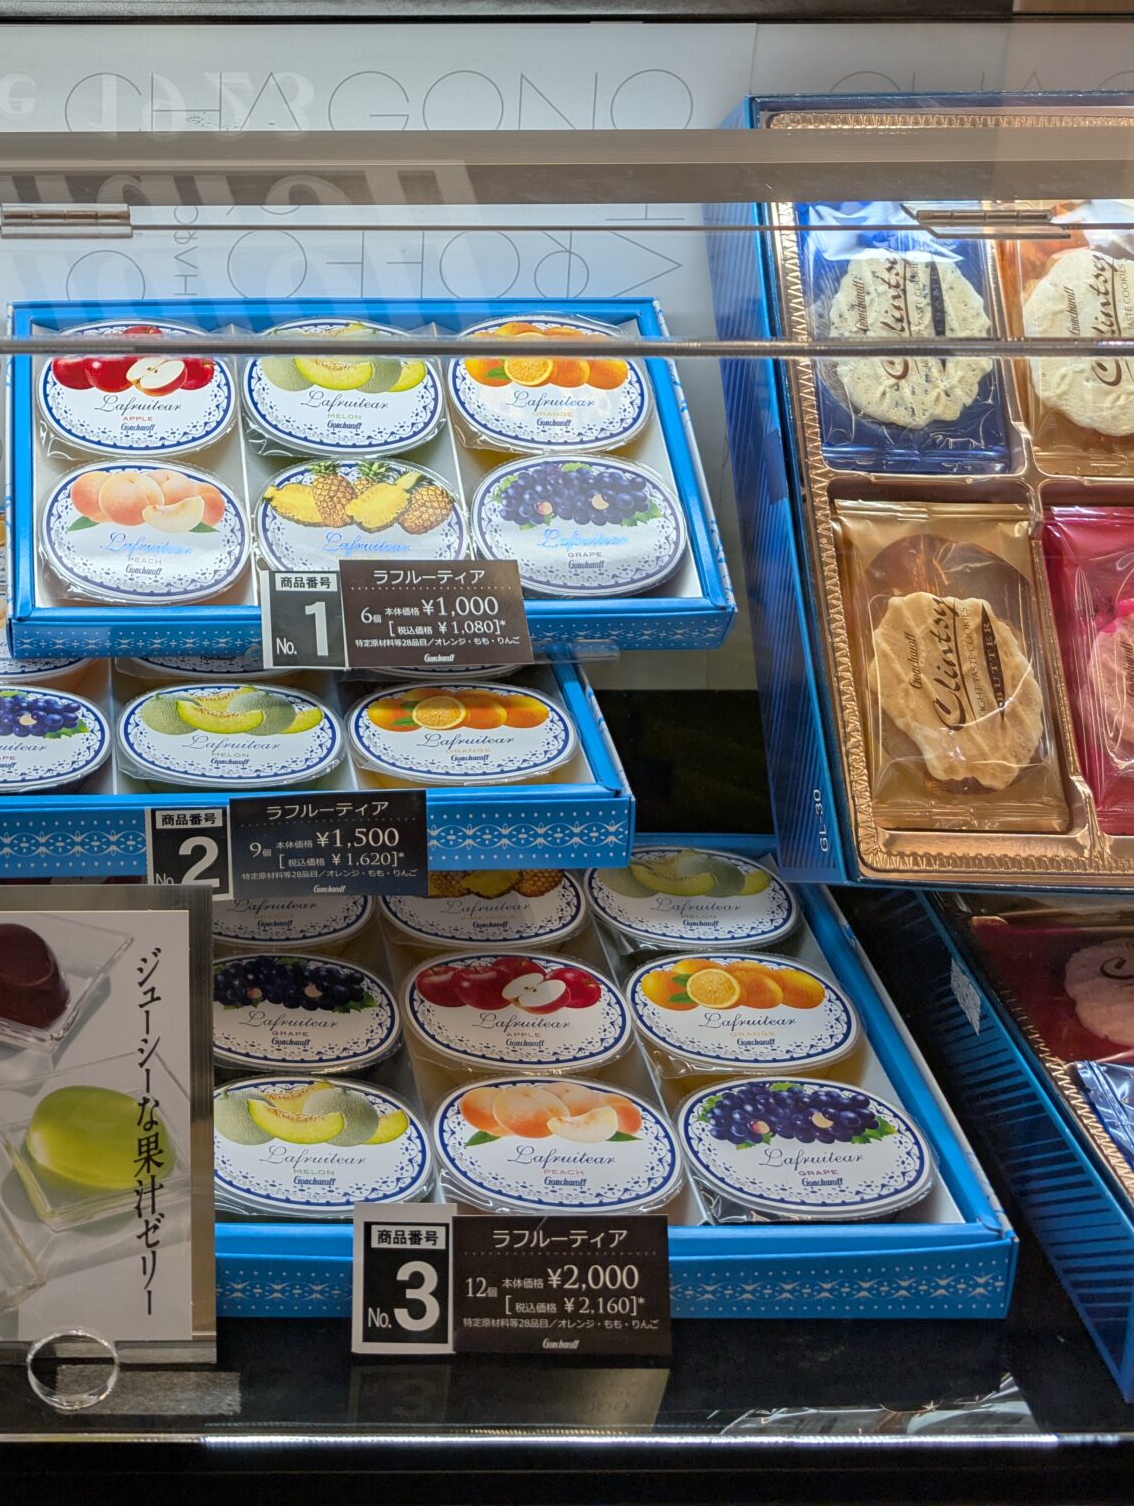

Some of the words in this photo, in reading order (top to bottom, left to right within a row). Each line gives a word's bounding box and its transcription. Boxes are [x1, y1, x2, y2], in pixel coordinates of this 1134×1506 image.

[94, 394, 182, 413] Lafruitear
[300, 390, 389, 412] Lafruitear
[506, 390, 595, 412] Lafruitear
[127, 556, 163, 565] PEACH
[280, 576, 332, 590] 商品番号
[373, 569, 486, 585] ラフルーティア
[385, 606, 420, 617] 本体価格
[422, 596, 500, 617] ¥1,000
[276, 637, 298, 655] No.
[305, 601, 329, 657] 1
[931, 594, 965, 731] Clintsy
[182, 737, 281, 757] Lafruitear
[417, 734, 514, 750] Lafruitear
[161, 812, 217, 826] 商品番号
[266, 801, 389, 820] ラフルーティア
[812, 788, 829, 852] GL-30
[276, 839, 313, 849] 本体価格
[316, 827, 400, 849] ¥1,500
[178, 836, 220, 888] 2
[226, 899, 317, 915] Lafruitear
[650, 897, 741, 915] Lafruitear
[238, 1010, 338, 1031] Lafruitear
[470, 1012, 570, 1033] Lafruitear
[698, 1012, 797, 1032] Lafruitear
[133, 947, 165, 1316] ジューシーな果汁ゼリー
[259, 1145, 366, 1168] Lafruitear
[507, 1145, 616, 1168] Lafruitear
[758, 1148, 864, 1171] Lafruitear
[798, 1169, 840, 1177] GRAPE
[377, 1228, 439, 1246] 商品番号
[492, 1229, 628, 1249] ラフルーティア
[501, 1277, 544, 1289] 本体価格
[547, 1264, 640, 1291] ¥2,000
[367, 1306, 393, 1329] No.
[393, 1260, 441, 1332] 3
